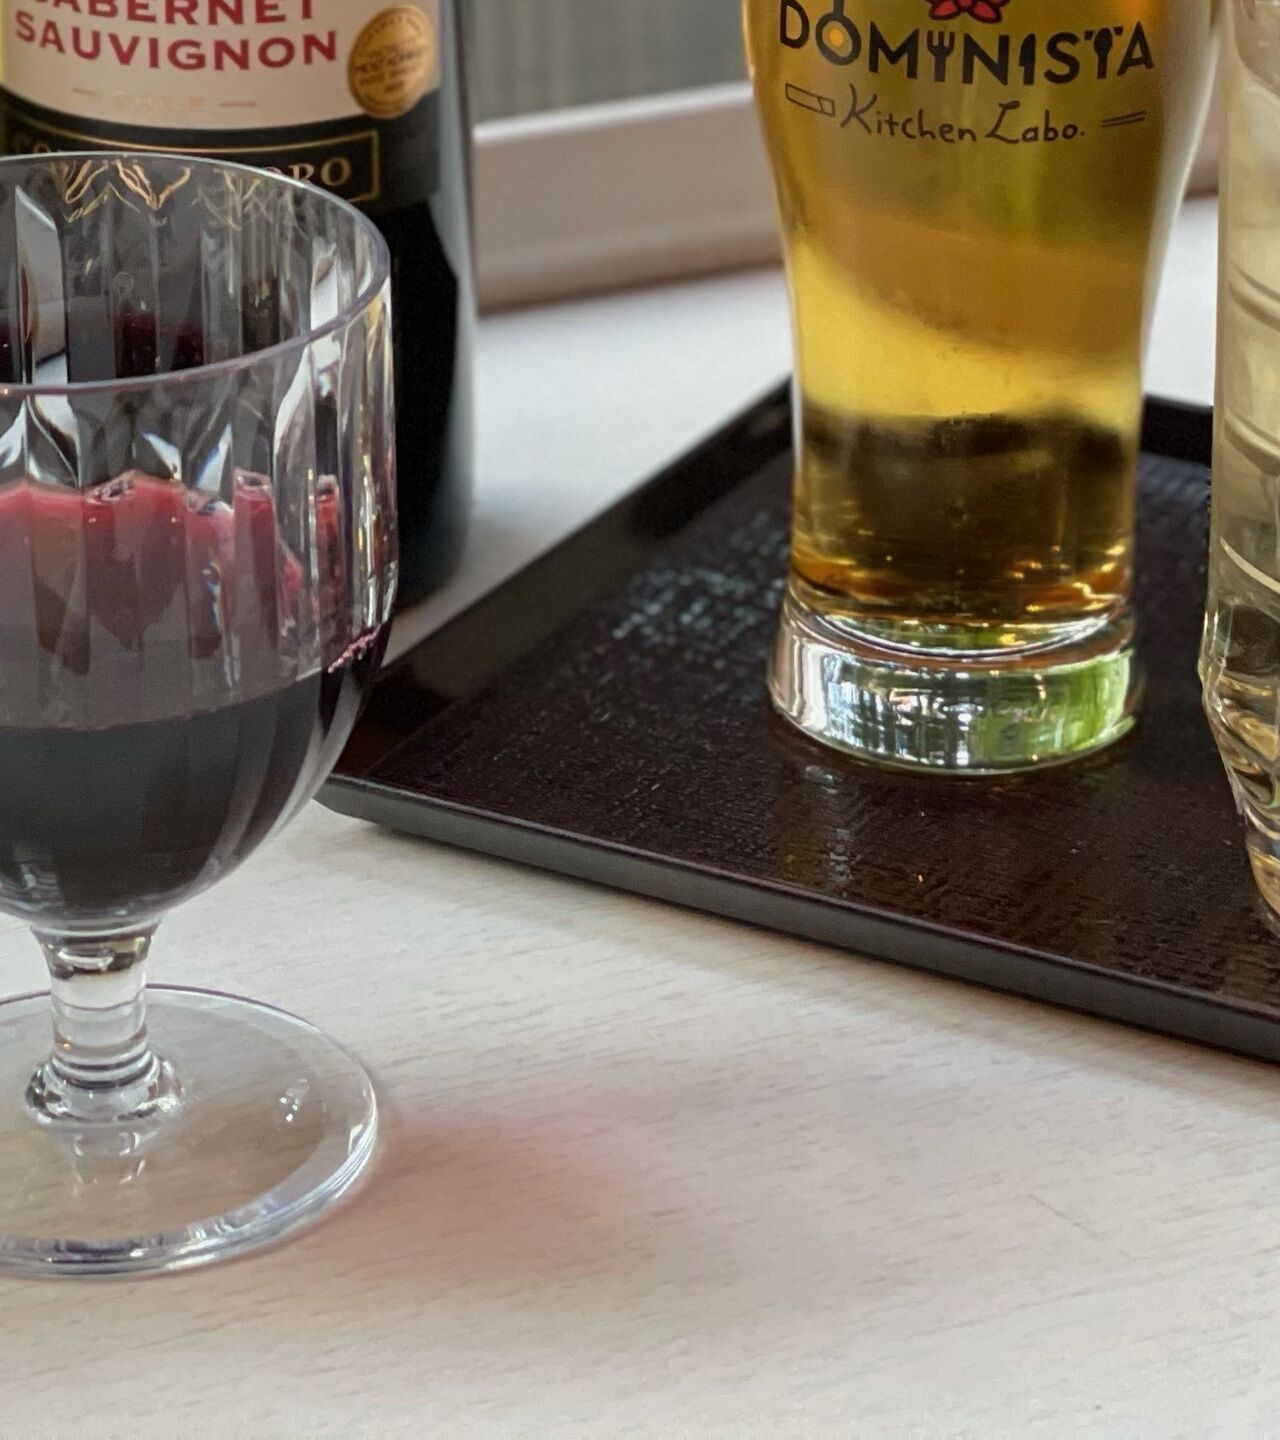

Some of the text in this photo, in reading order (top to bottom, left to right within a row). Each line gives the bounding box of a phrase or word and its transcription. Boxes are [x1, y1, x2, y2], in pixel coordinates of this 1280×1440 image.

[16, 10, 337, 71] SAUVIGNON
[840, 83, 1085, 144] Kitchen Labo.
